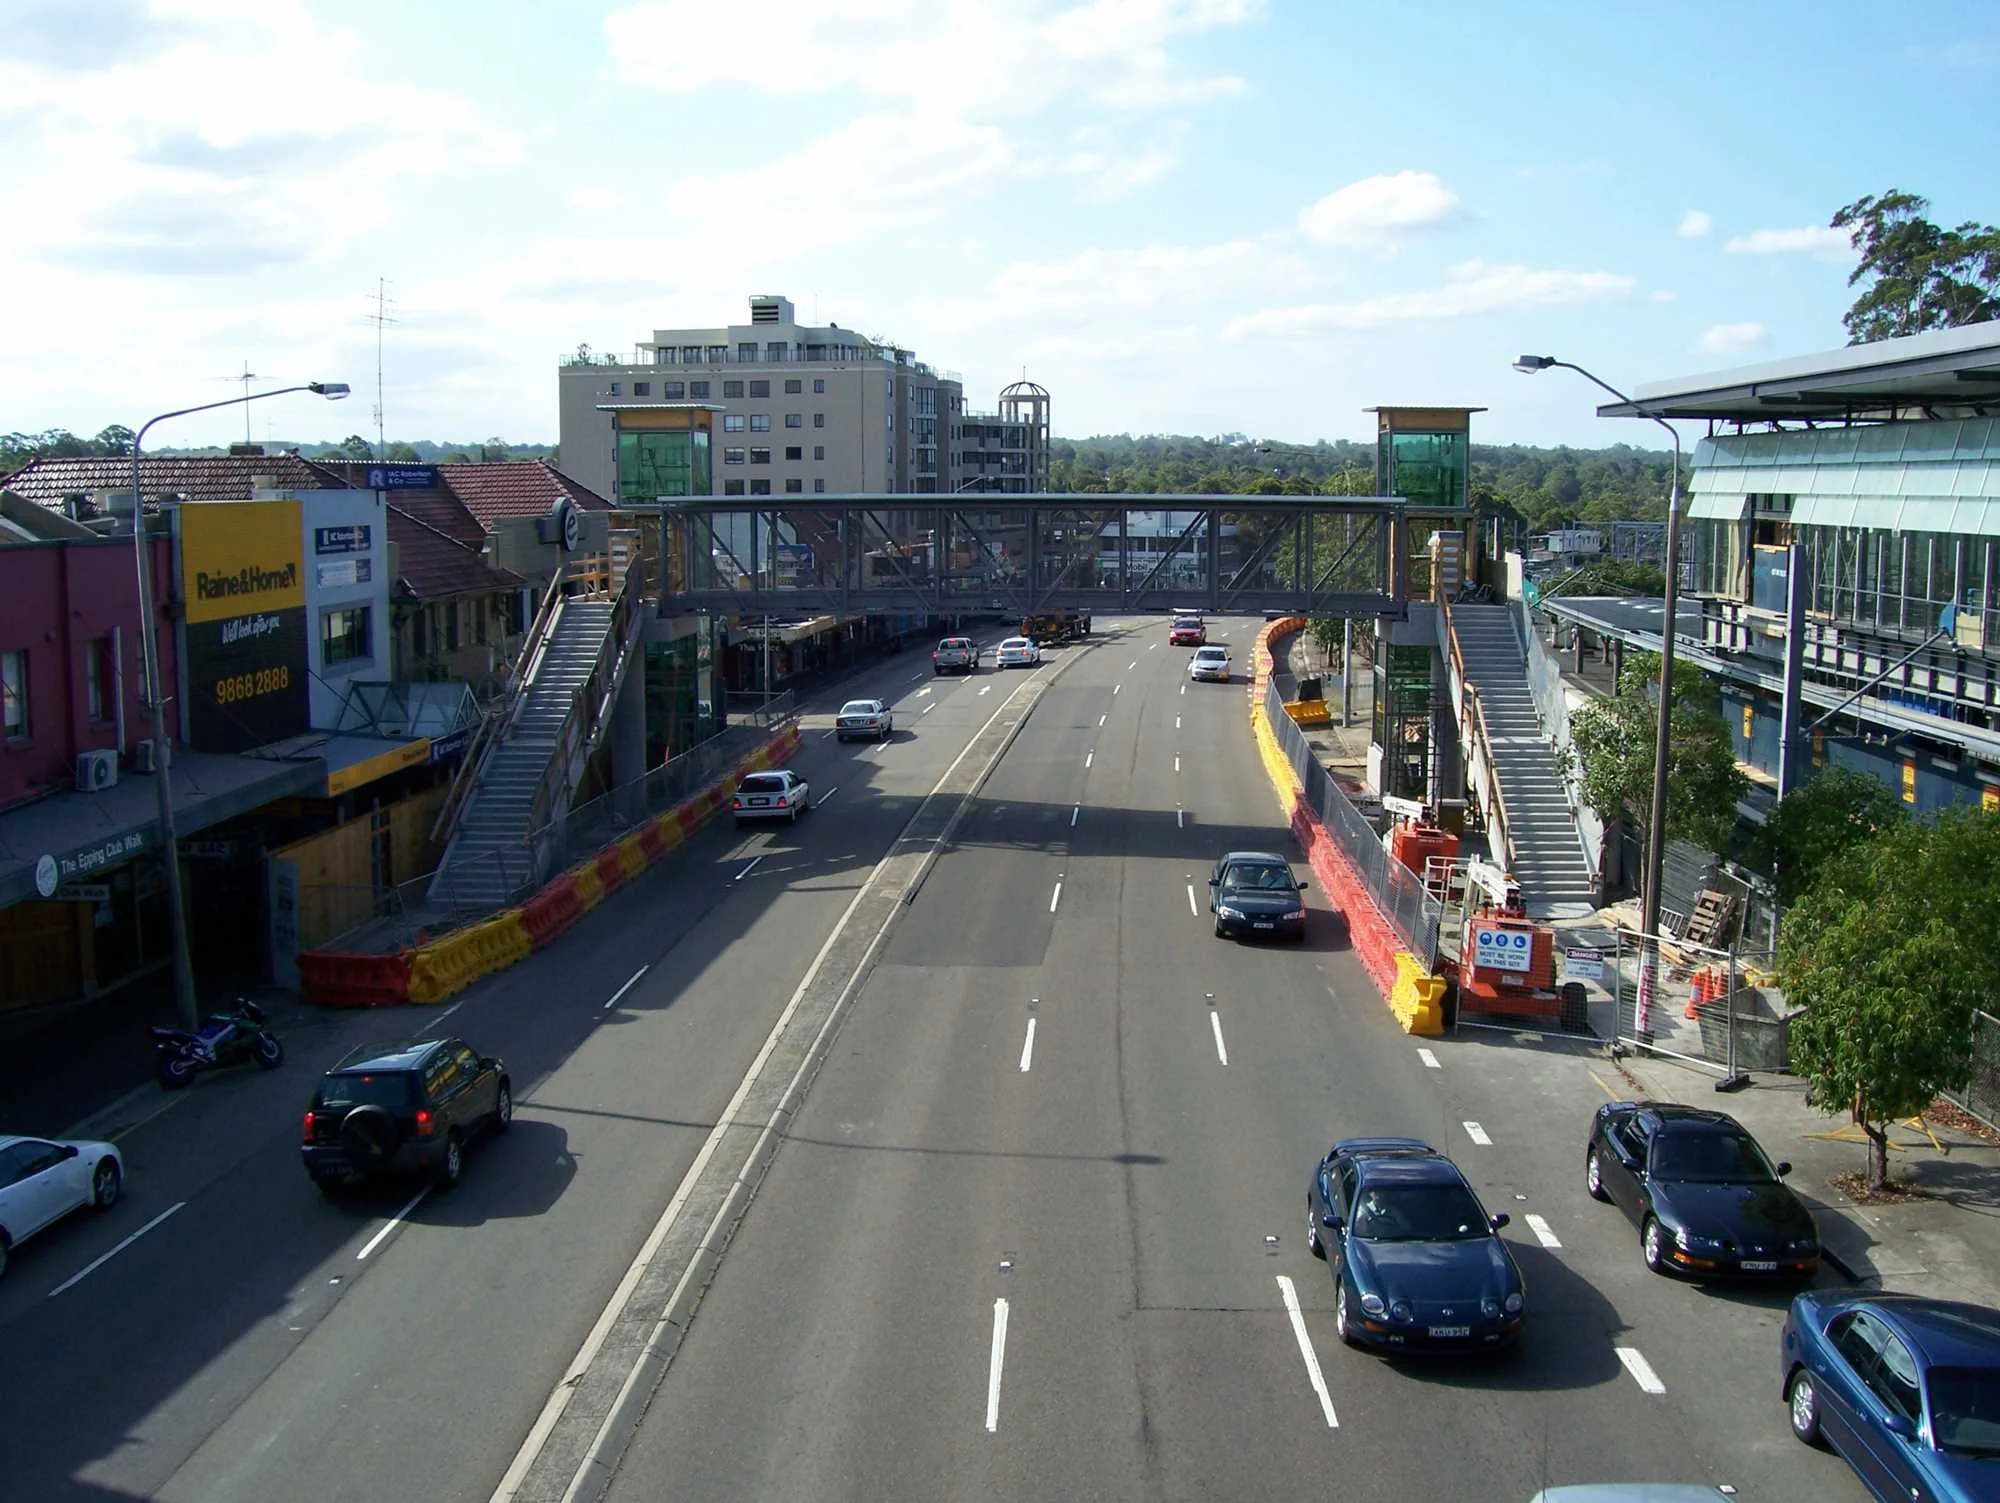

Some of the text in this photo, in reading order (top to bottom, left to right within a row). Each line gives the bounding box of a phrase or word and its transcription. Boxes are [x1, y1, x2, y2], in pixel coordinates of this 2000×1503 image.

[216, 666, 288, 704] 9868 2888
[61, 860, 77, 875] The
[78, 848, 105, 870] Epping
[106, 840, 124, 857] Club
